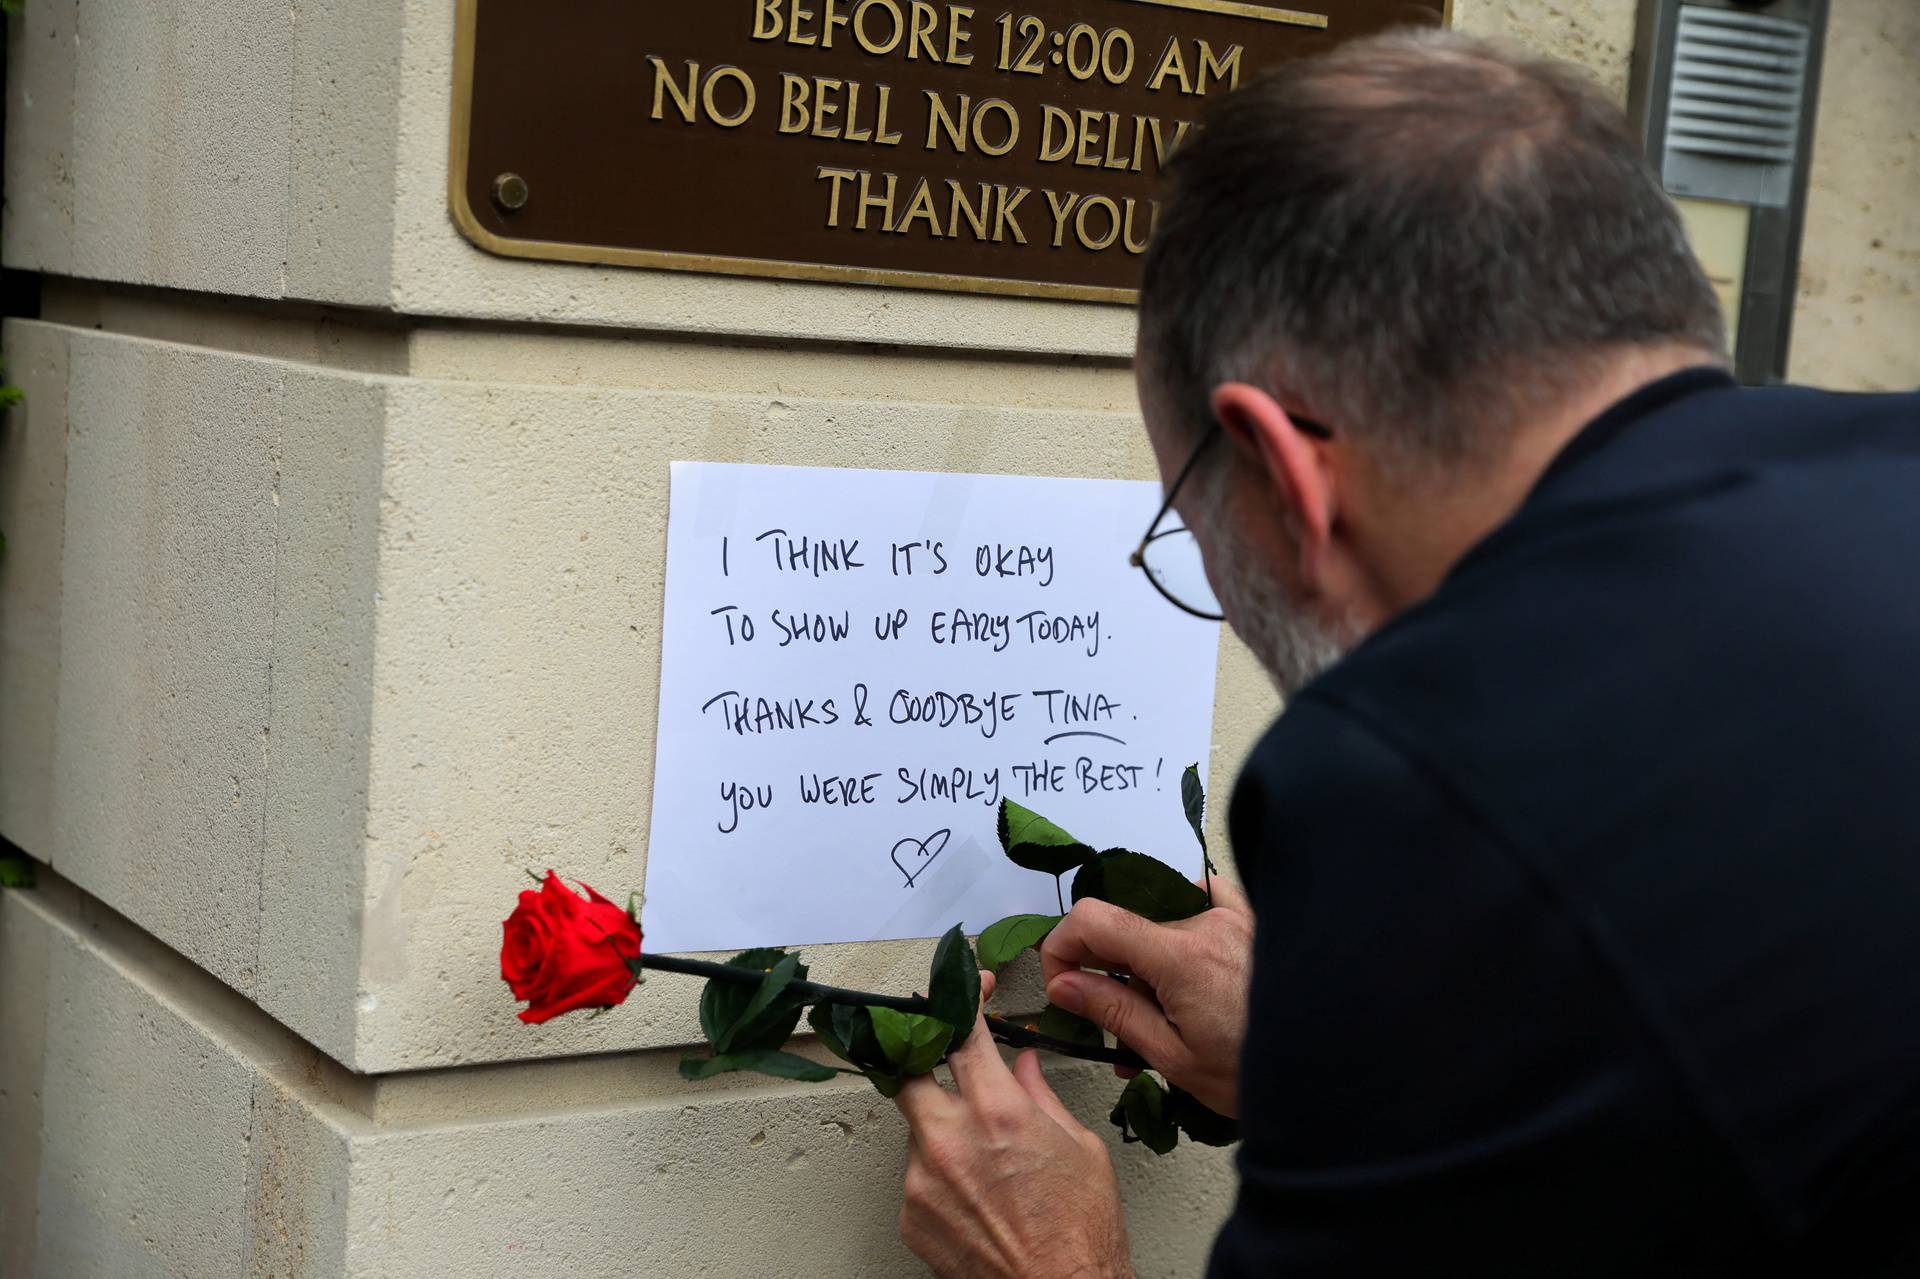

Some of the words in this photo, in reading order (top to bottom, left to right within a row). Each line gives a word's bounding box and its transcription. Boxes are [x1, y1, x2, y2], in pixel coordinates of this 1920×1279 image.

[752, 0, 975, 66] BEFORE
[994, 12, 1135, 85] 12:00
[1146, 34, 1244, 96] AM
[646, 54, 757, 127] NO
[778, 71, 903, 145] BELL
[922, 89, 1020, 156] NO
[1037, 103, 1206, 172] DELIV
[816, 165, 1032, 245] THANK
[1041, 188, 1162, 254] YOU
[722, 536, 729, 577] I
[756, 528, 865, 578] THINK
[891, 540, 948, 576] IT'S
[975, 543, 1054, 587] OKAY
[710, 605, 755, 646] TO
[771, 609, 849, 647] SHOW
[874, 610, 908, 641] UP
[931, 609, 1010, 653] EARLY
[1016, 610, 1112, 658] TODAY.
[702, 690, 840, 736] THANKS
[853, 683, 873, 727] &
[888, 688, 1022, 739] GOODBYE
[799, 771, 883, 807] WERE
[897, 765, 1000, 807] SIMPLY
[1011, 759, 1066, 797] THE
